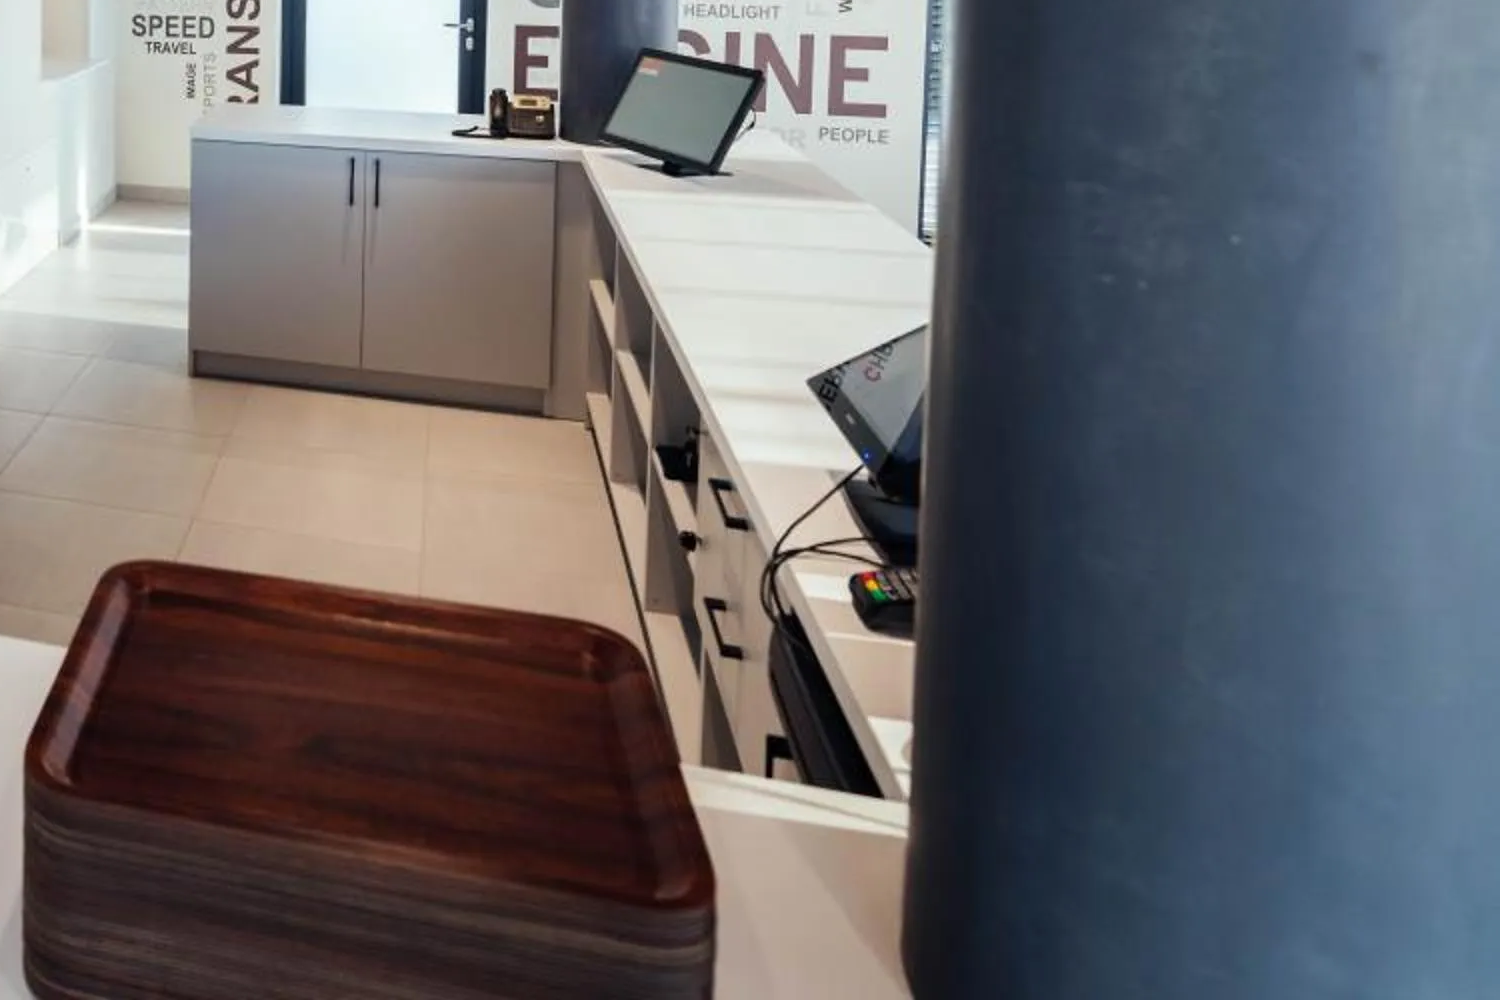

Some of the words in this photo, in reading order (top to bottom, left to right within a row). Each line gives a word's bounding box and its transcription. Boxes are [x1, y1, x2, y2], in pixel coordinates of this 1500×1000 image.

[684, 3, 780, 21] HEADLIGHT
[132, 14, 215, 39] SPEED
[145, 41, 197, 56] TRAVEL
[513, 23, 889, 119] EINE
[203, 53, 218, 114] PORTS
[819, 126, 890, 144] PEOPLE
